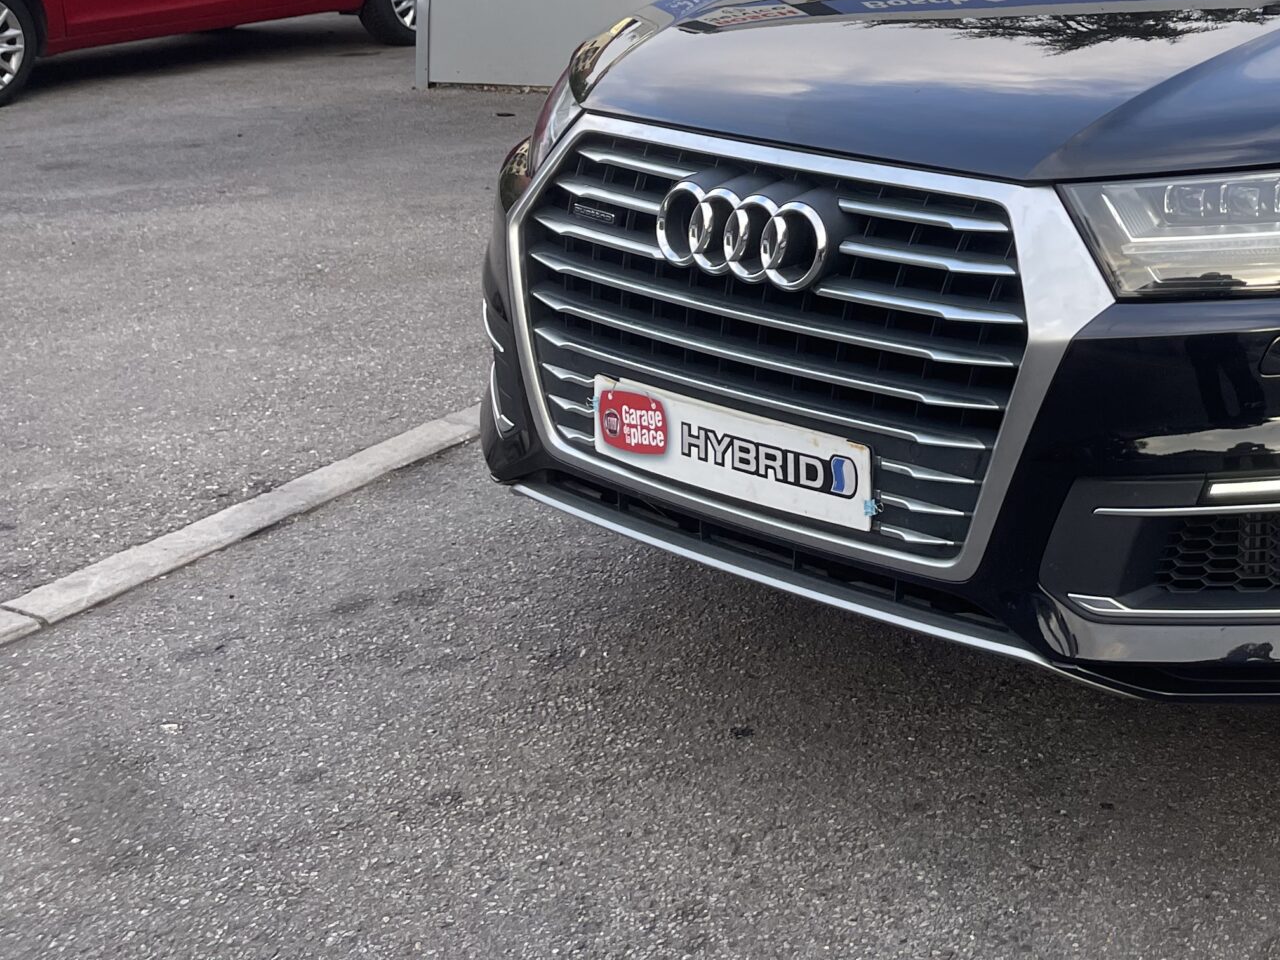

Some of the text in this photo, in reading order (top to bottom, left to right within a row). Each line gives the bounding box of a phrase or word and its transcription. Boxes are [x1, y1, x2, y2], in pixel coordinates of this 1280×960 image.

[621, 405, 663, 429] Garage
[630, 426, 665, 447] place
[681, 422, 825, 489] HYBRID
